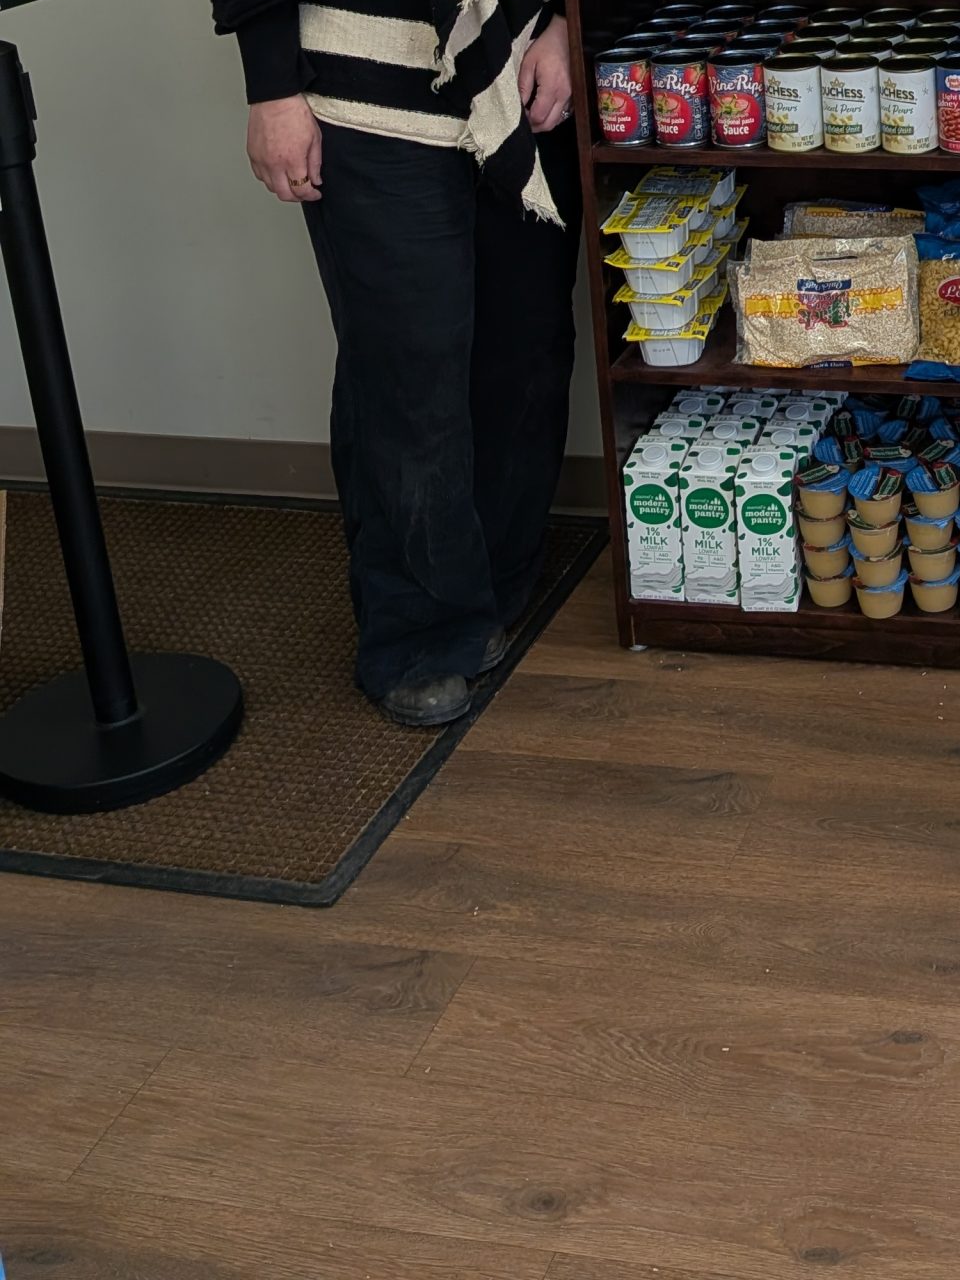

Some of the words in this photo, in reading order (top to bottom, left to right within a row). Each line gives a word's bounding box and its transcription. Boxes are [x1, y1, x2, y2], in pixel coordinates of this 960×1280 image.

[942, 94, 956, 103] Light
[724, 125, 749, 135] Sauce
[646, 527, 660, 536] 1%
[640, 537, 667, 545] MILK
[695, 540, 723, 549] MILK
[752, 547, 780, 556] MILK
